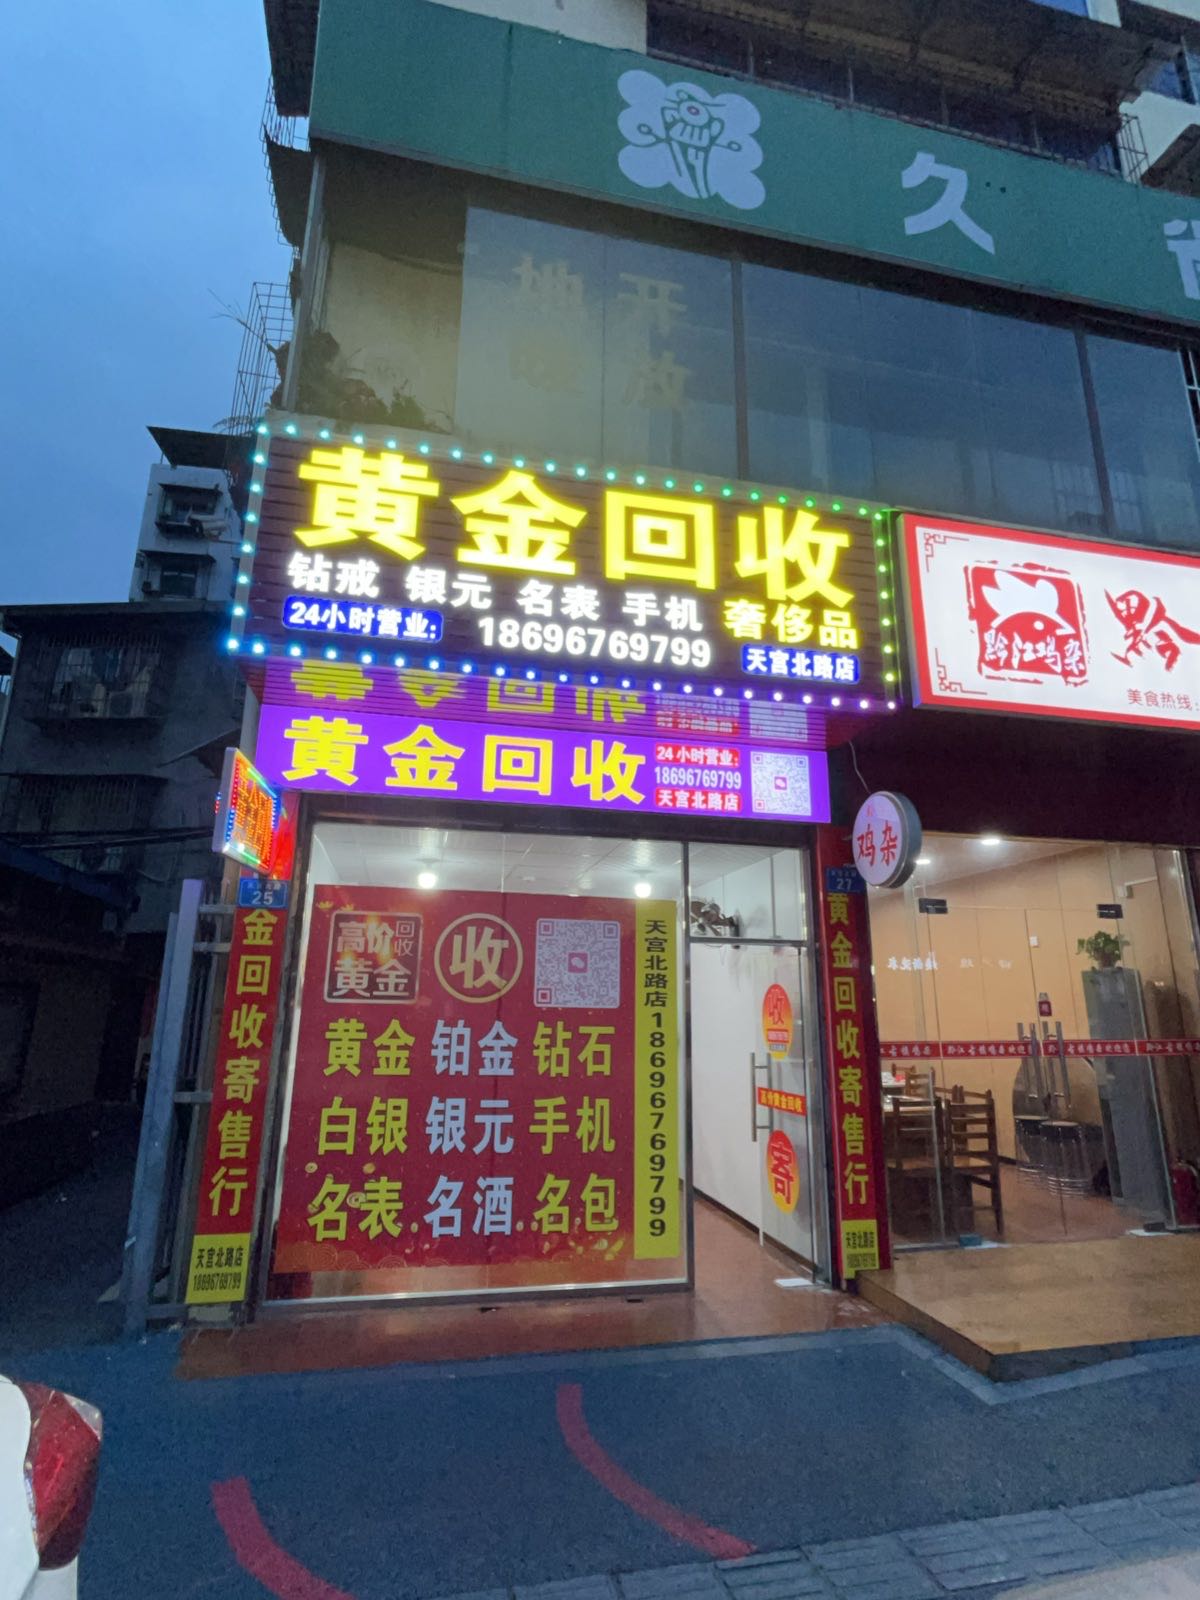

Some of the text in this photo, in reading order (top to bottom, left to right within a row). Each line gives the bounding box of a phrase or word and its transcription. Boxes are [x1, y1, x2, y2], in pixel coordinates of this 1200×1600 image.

[902, 151, 995, 255] 久
[294, 445, 854, 608] 黄金回收
[287, 551, 859, 650] 钻戒 银元 名表 手机 奢侈品
[478, 615, 712, 669] 18696769799
[745, 646, 856, 682] 天宫北路店
[282, 715, 646, 805] 黄金回收
[654, 766, 742, 790] 18696769799
[657, 789, 740, 812] 天宫北路店
[857, 819, 898, 867] 鸡杂
[251, 890, 274, 905] 25
[336, 921, 394, 953] 高价
[394, 920, 415, 957] 回收
[449, 926, 510, 989] 收
[332, 958, 411, 997] 黄金
[208, 909, 278, 1217] 金回收寄售行
[323, 1019, 616, 1077] 黄金 铂金 钻石
[828, 893, 869, 1205] 黄金回收寄售行
[317, 1096, 616, 1156] 白银 银元 手机
[307, 1173, 620, 1242] 名表 名酒 名包
[196, 1246, 243, 1269] 天宫北路店
